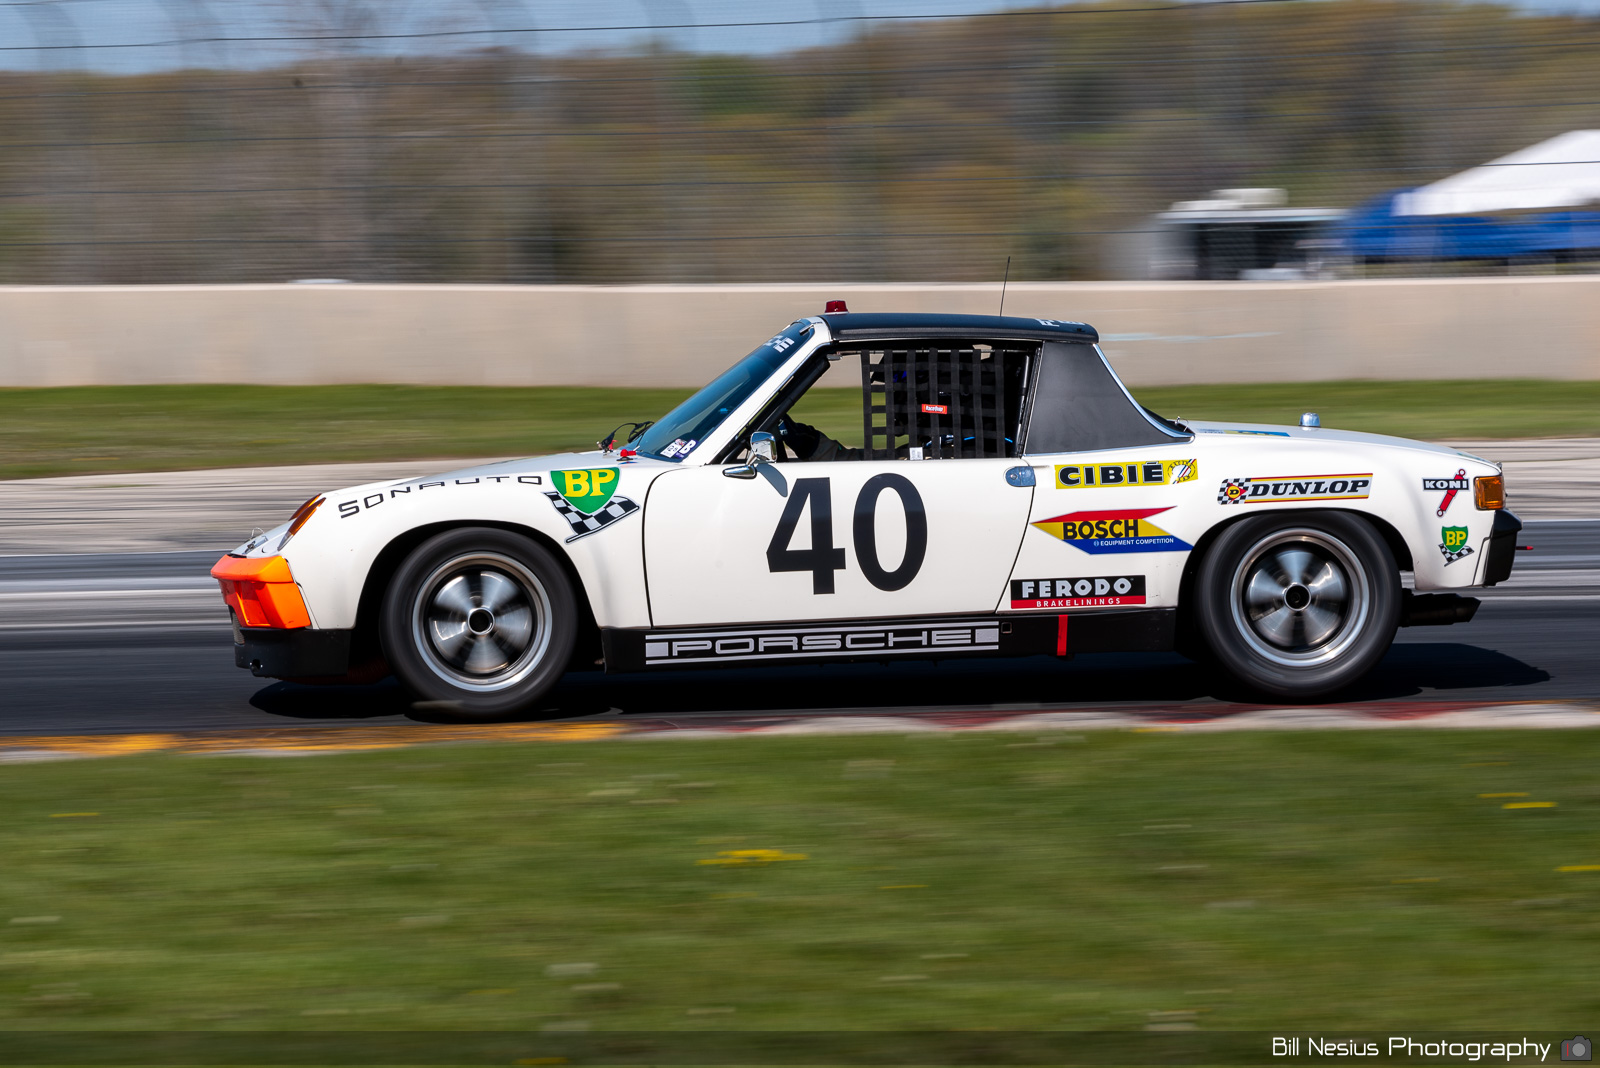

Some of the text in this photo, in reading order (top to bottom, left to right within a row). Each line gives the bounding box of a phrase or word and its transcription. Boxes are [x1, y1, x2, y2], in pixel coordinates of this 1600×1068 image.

[560, 469, 615, 497] BP
[1248, 479, 1369, 497] DUNLOP
[1425, 480, 1468, 489] KONI
[338, 476, 542, 519] SONAUTO
[766, 472, 928, 595] 40
[1062, 519, 1139, 540] BOSCH
[1445, 531, 1467, 546] BP
[1135, 537, 1174, 545] COMPETITION
[1022, 577, 1132, 598] FERODO
[1036, 597, 1121, 607] BRAKELININGS
[672, 629, 972, 657] PORSCHE
